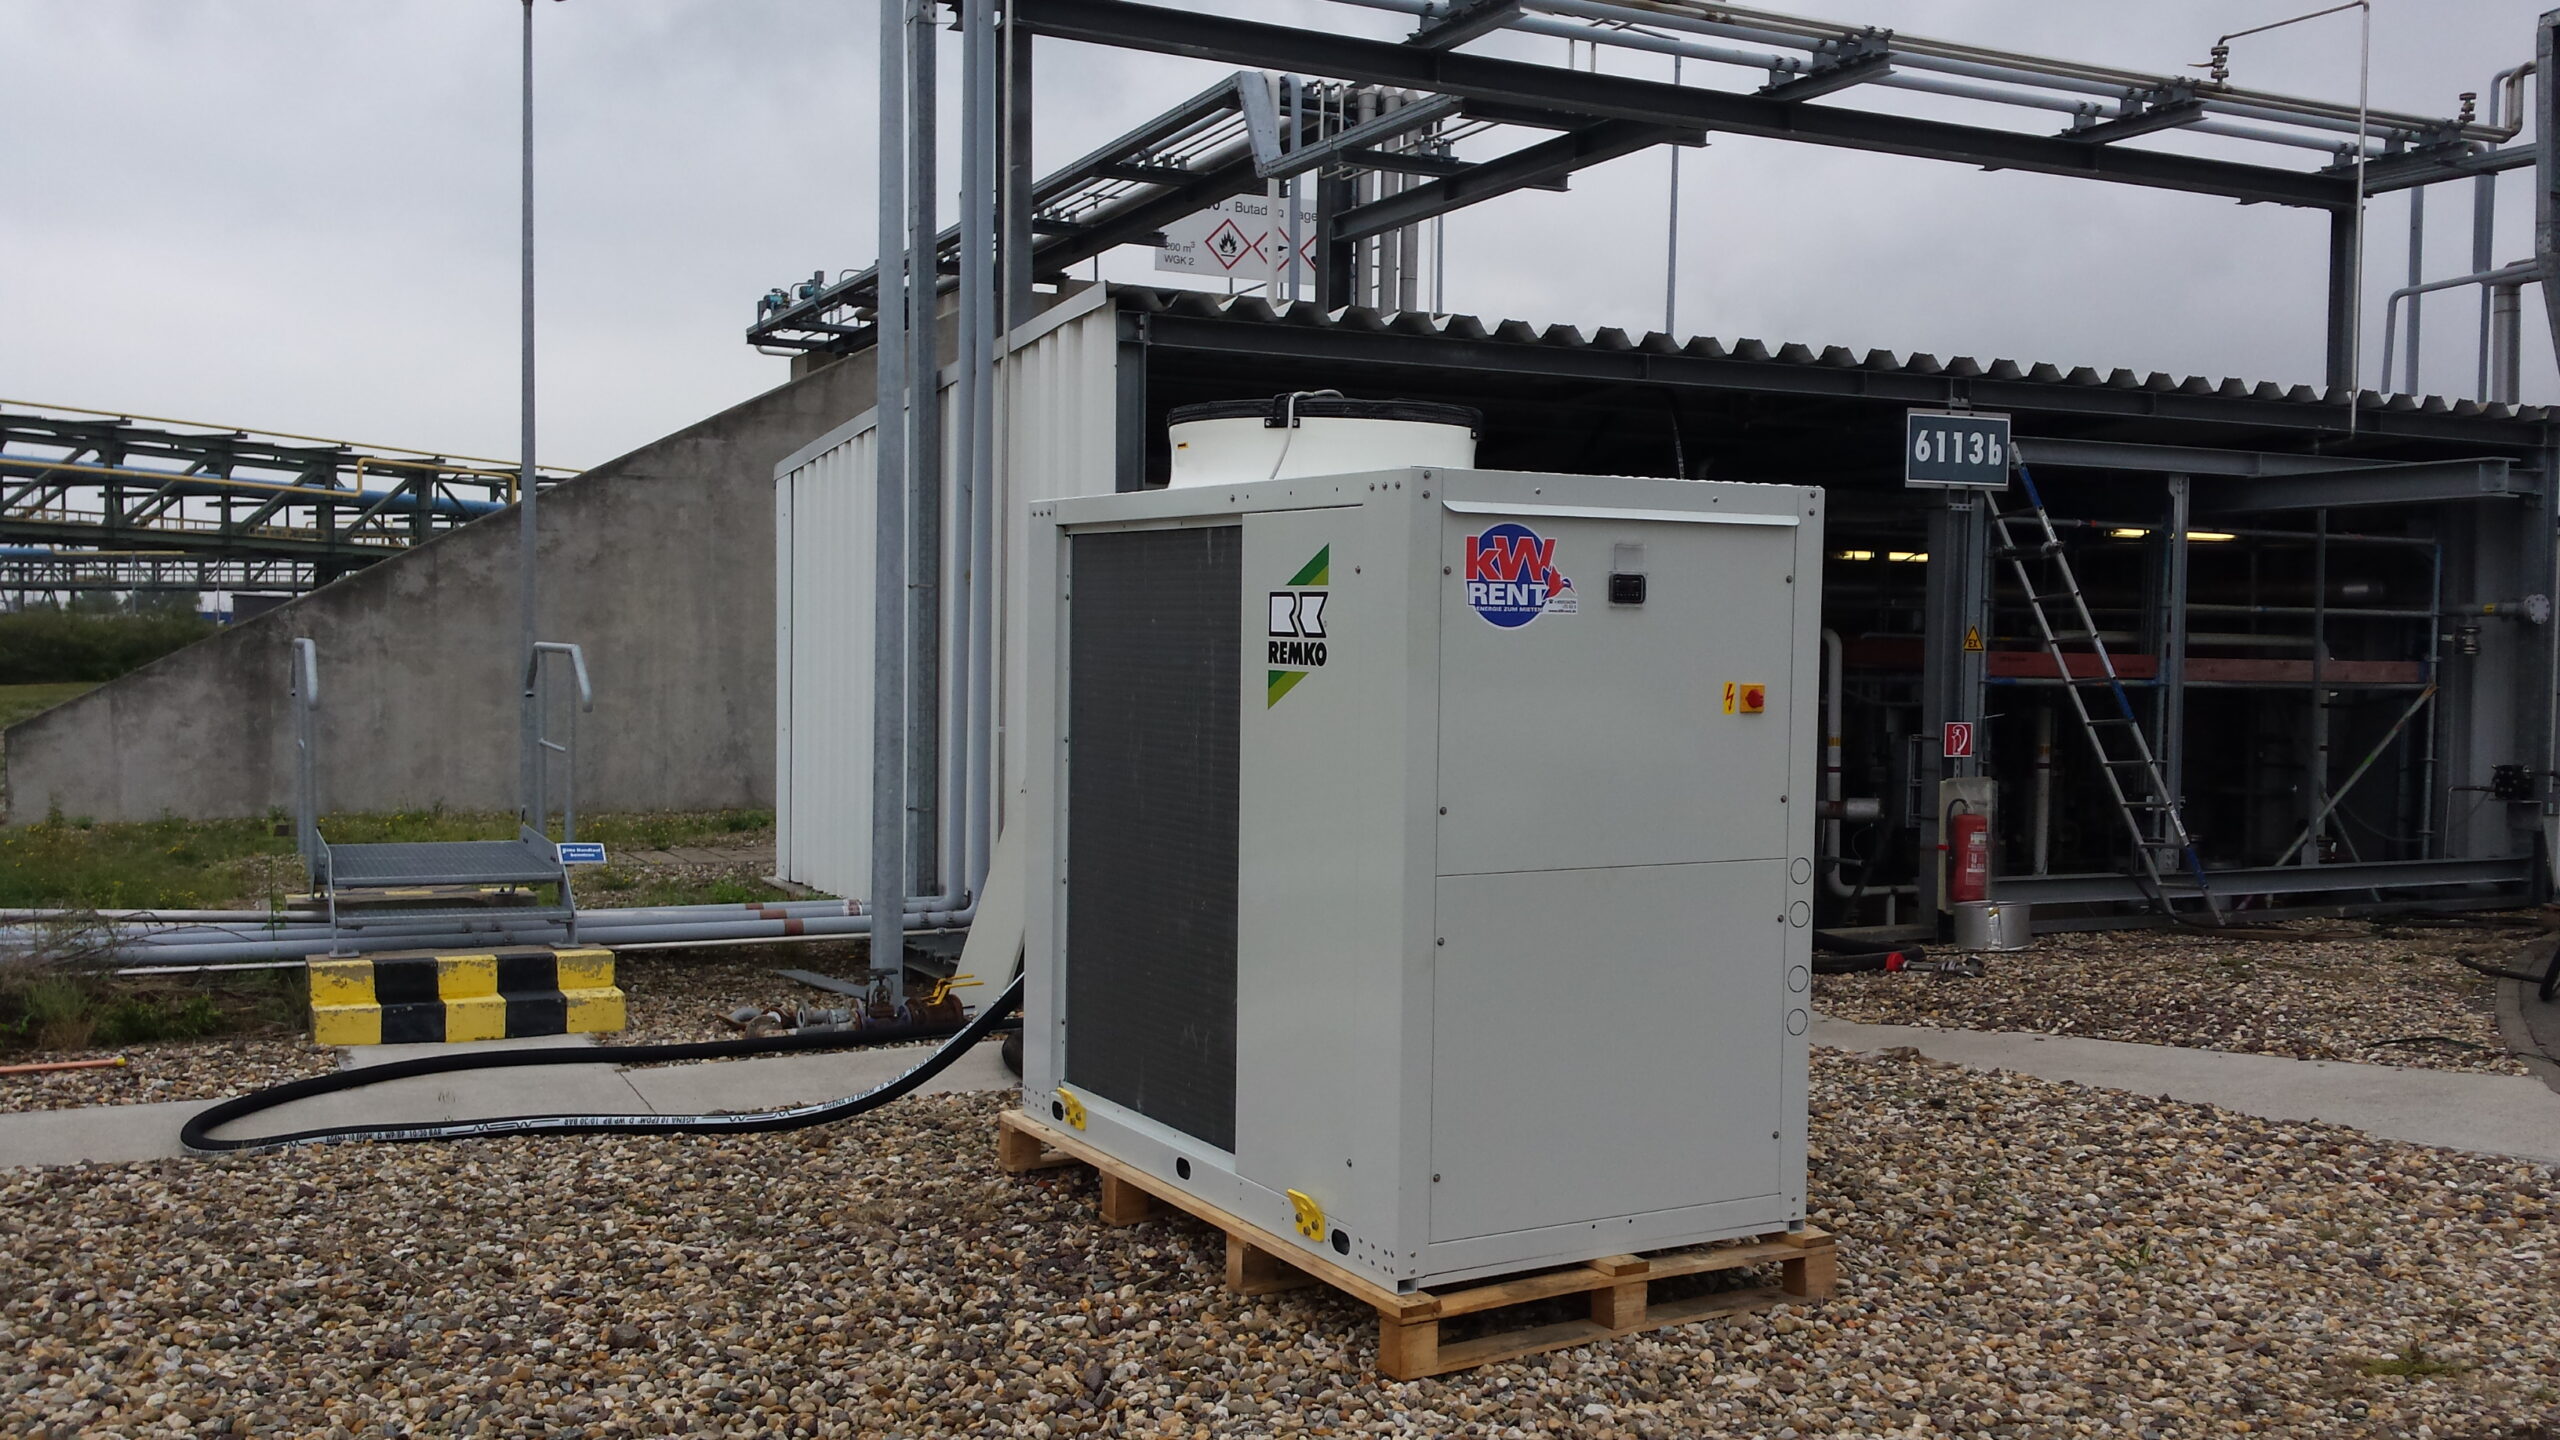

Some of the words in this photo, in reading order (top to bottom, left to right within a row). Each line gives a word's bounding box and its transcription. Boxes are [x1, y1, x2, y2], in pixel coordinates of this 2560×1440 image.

[1235, 201, 1285, 218] Butadn
[1164, 254, 1187, 265] WGK
[1188, 257, 1195, 266] 2
[1914, 429, 2003, 466] 6113b
[1469, 583, 1548, 606] RENT
[1268, 640, 1328, 667] REMKO
